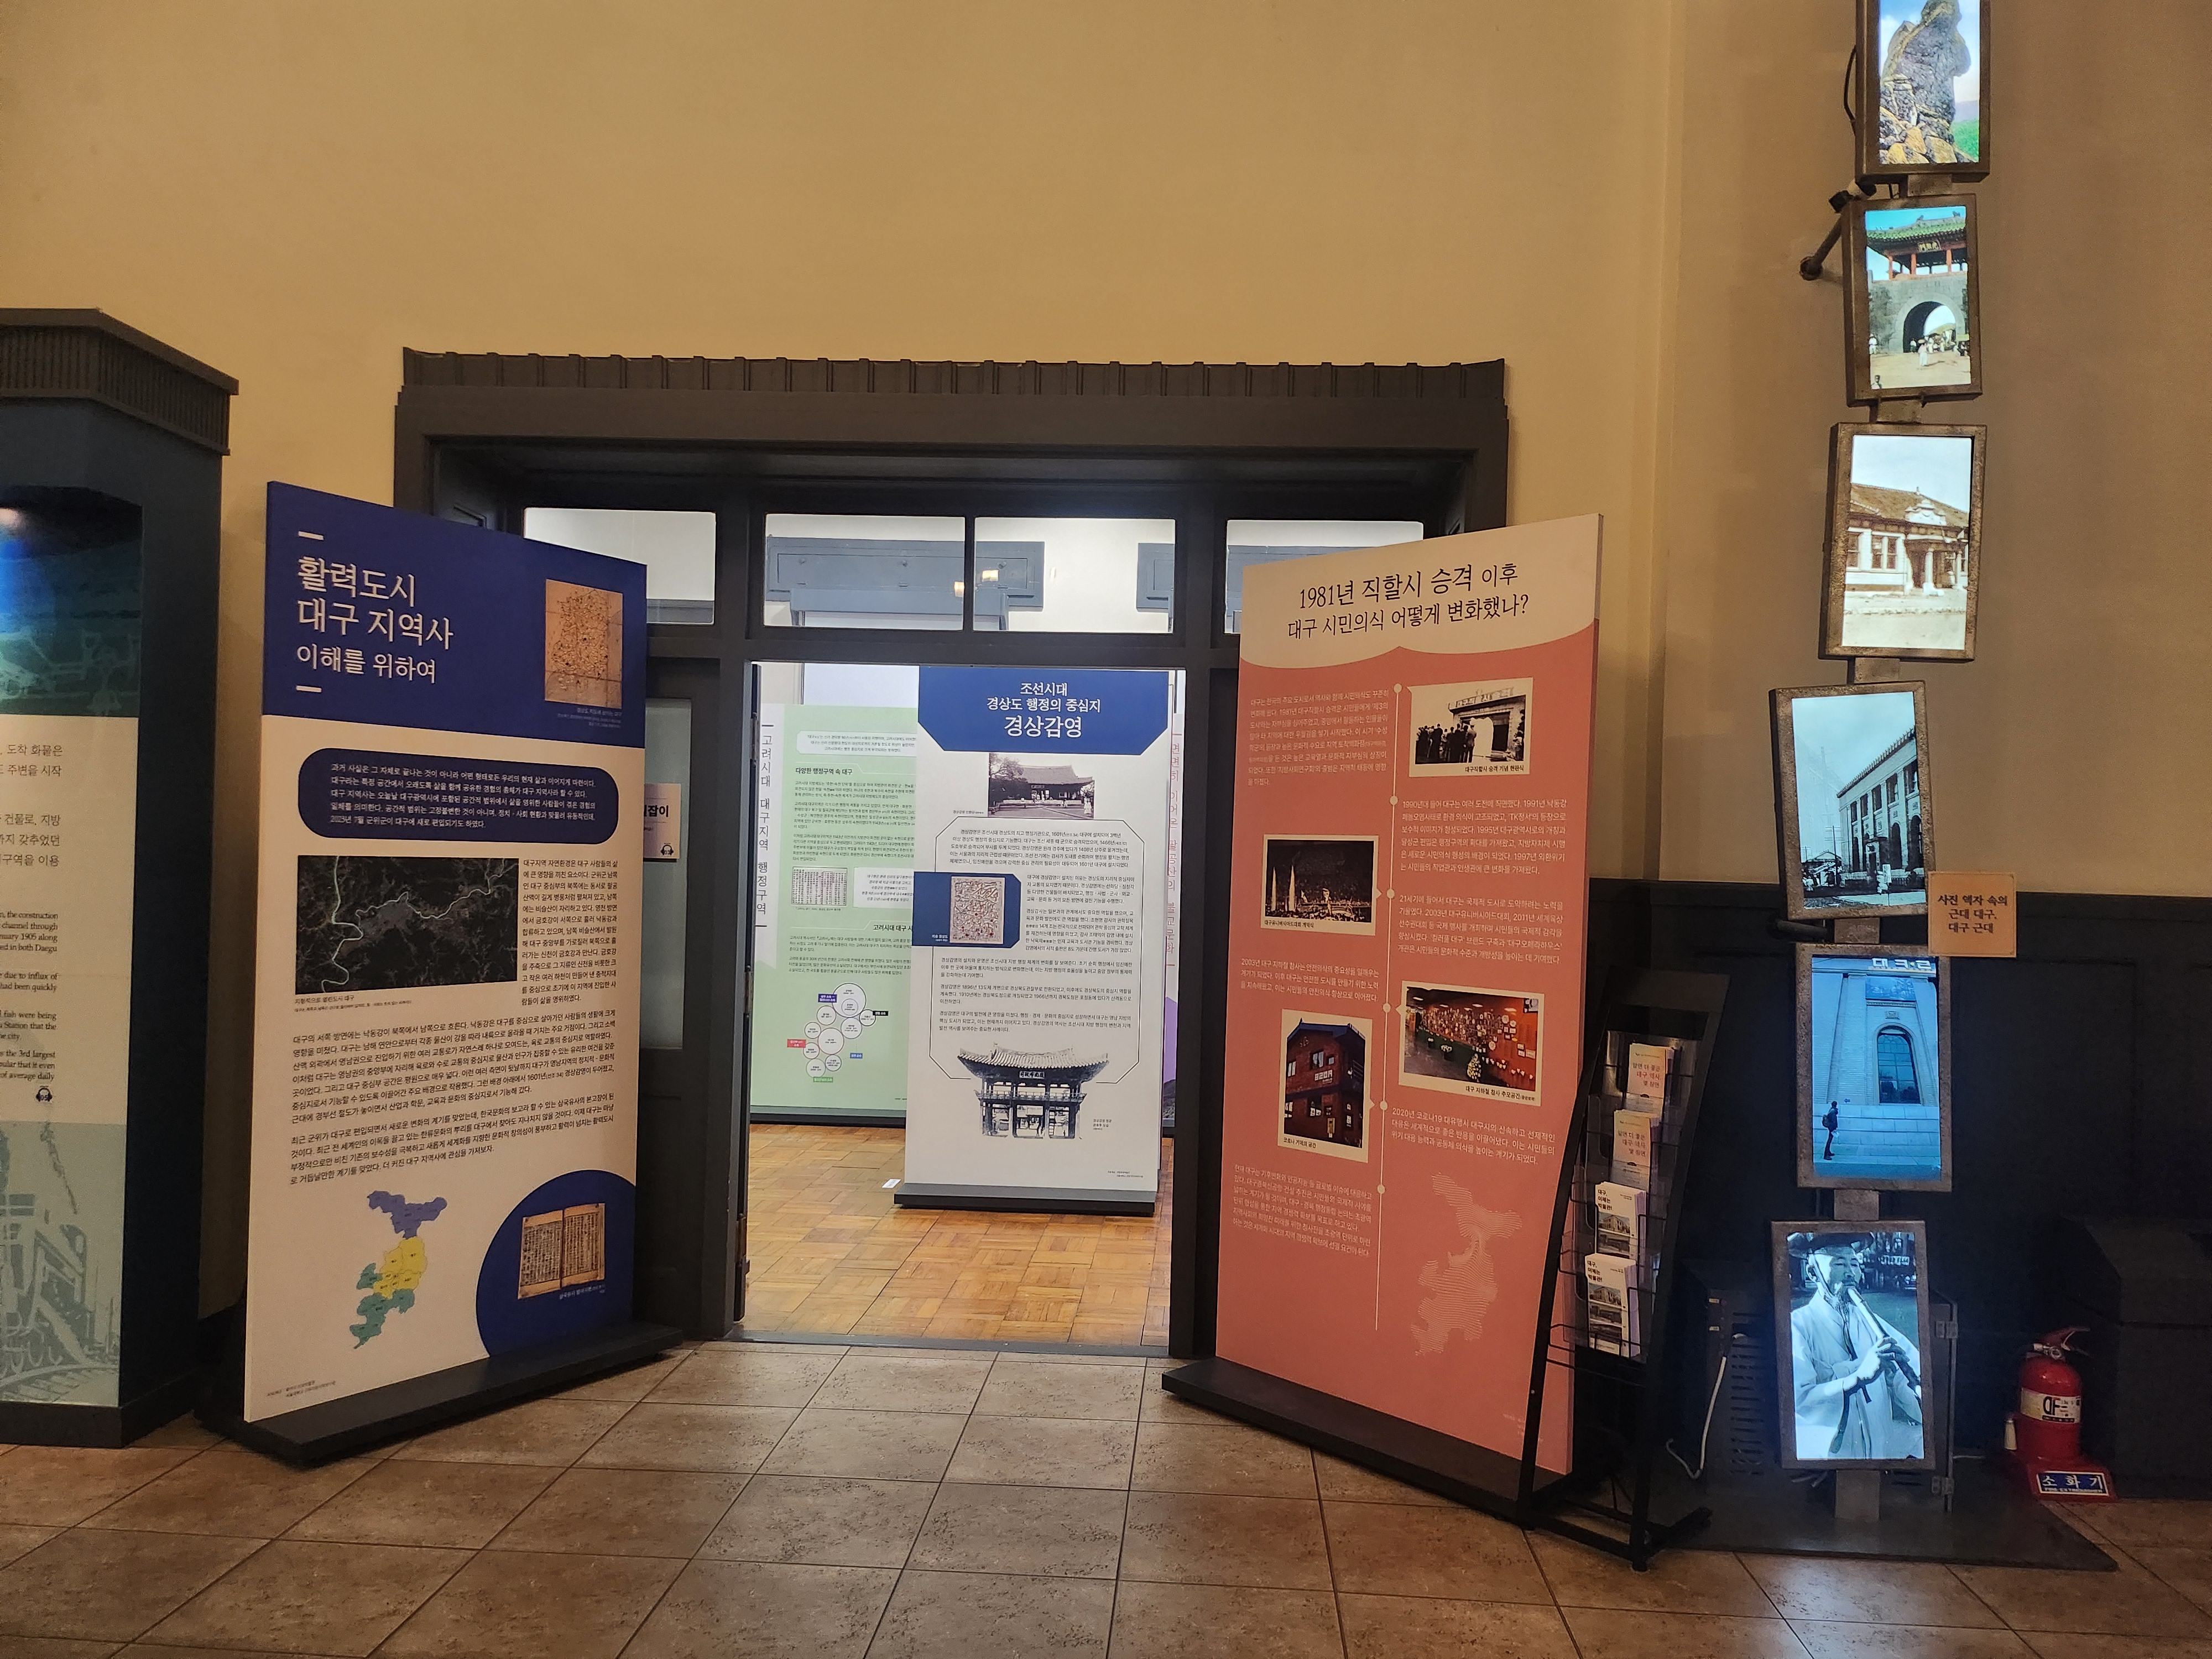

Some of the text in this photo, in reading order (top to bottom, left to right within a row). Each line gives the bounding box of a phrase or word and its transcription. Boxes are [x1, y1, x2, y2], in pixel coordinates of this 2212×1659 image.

[298, 555, 415, 607] 활력도시
[1300, 563, 1518, 609] 1981년 직할시 승격 이후
[298, 598, 453, 649] 대구 지역사
[1288, 594, 1529, 640] 대구 시민의식 어떻게 변화했나?
[297, 643, 436, 684] 이해를 위하여
[1020, 682, 1067, 697] 조선시대
[987, 696, 1101, 713] 경상도 행정의 중심지
[1004, 714, 1082, 738] 경상감영
[7, 744, 62, 757] 도착 화물은
[8, 764, 62, 777] 주변을 시작
[41, 814, 61, 826] 지방
[757, 735, 773, 915] 고려시대 대구지역 행정구역
[19, 833, 60, 847] 갖추었던
[0, 854, 59, 867] 구역을 이용
[1938, 894, 2007, 906] 사진 액자 속의
[1948, 909, 1969, 920] 근대
[31, 922, 58, 931] through
[1948, 922, 1994, 933] 대구 근대
[38, 933, 58, 943] along
[14, 982, 30, 990] been
[32, 983, 57, 993] quickly
[38, 1011, 57, 1021] being
[33, 1050, 55, 1060] largest
[9, 1073, 36, 1082] average
[38, 1072, 55, 1084] daily
